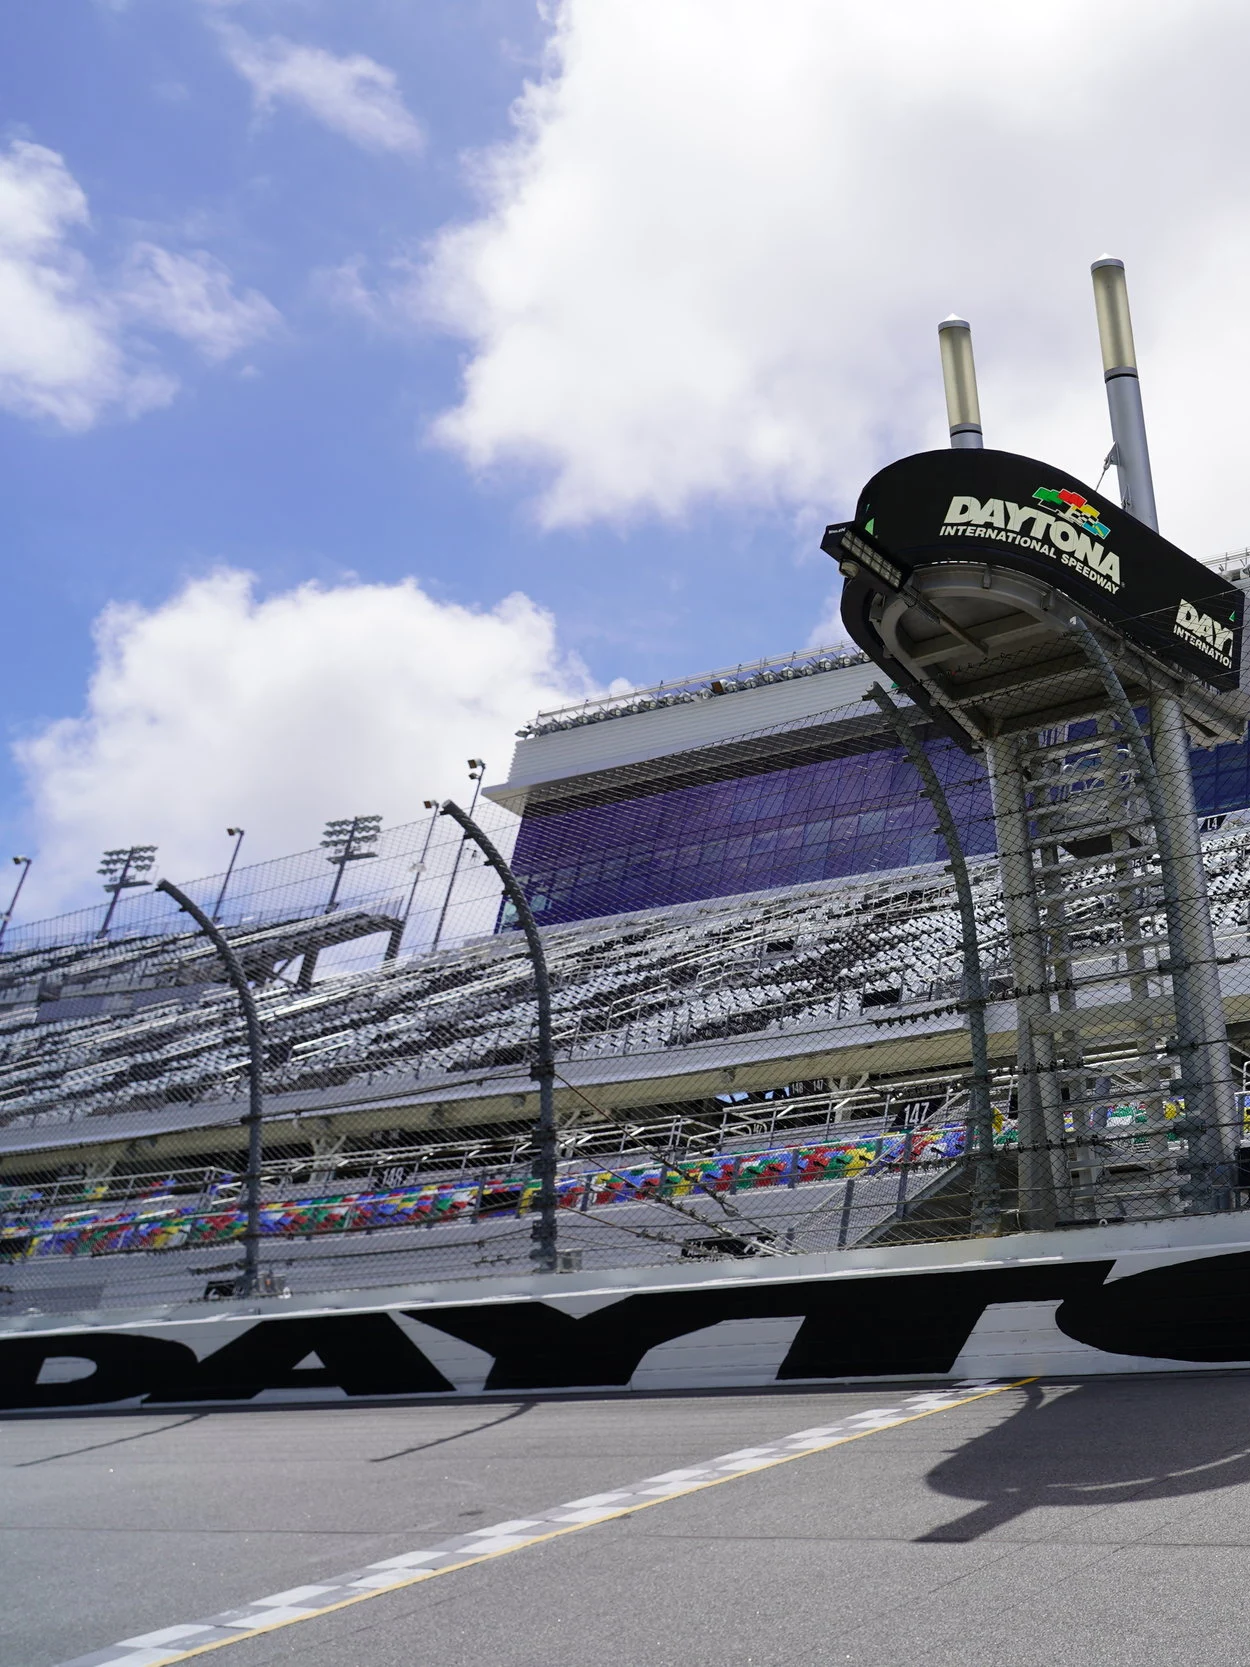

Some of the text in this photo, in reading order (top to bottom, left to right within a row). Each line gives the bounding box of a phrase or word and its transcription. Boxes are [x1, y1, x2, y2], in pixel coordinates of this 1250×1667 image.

[939, 526, 1120, 595] INTERNATIONAL SPEEDWAY
[943, 495, 1121, 584] DAYTONA
[1175, 598, 1234, 658] DAY
[1207, 817, 1218, 831] L4
[904, 1101, 930, 1129] 147
